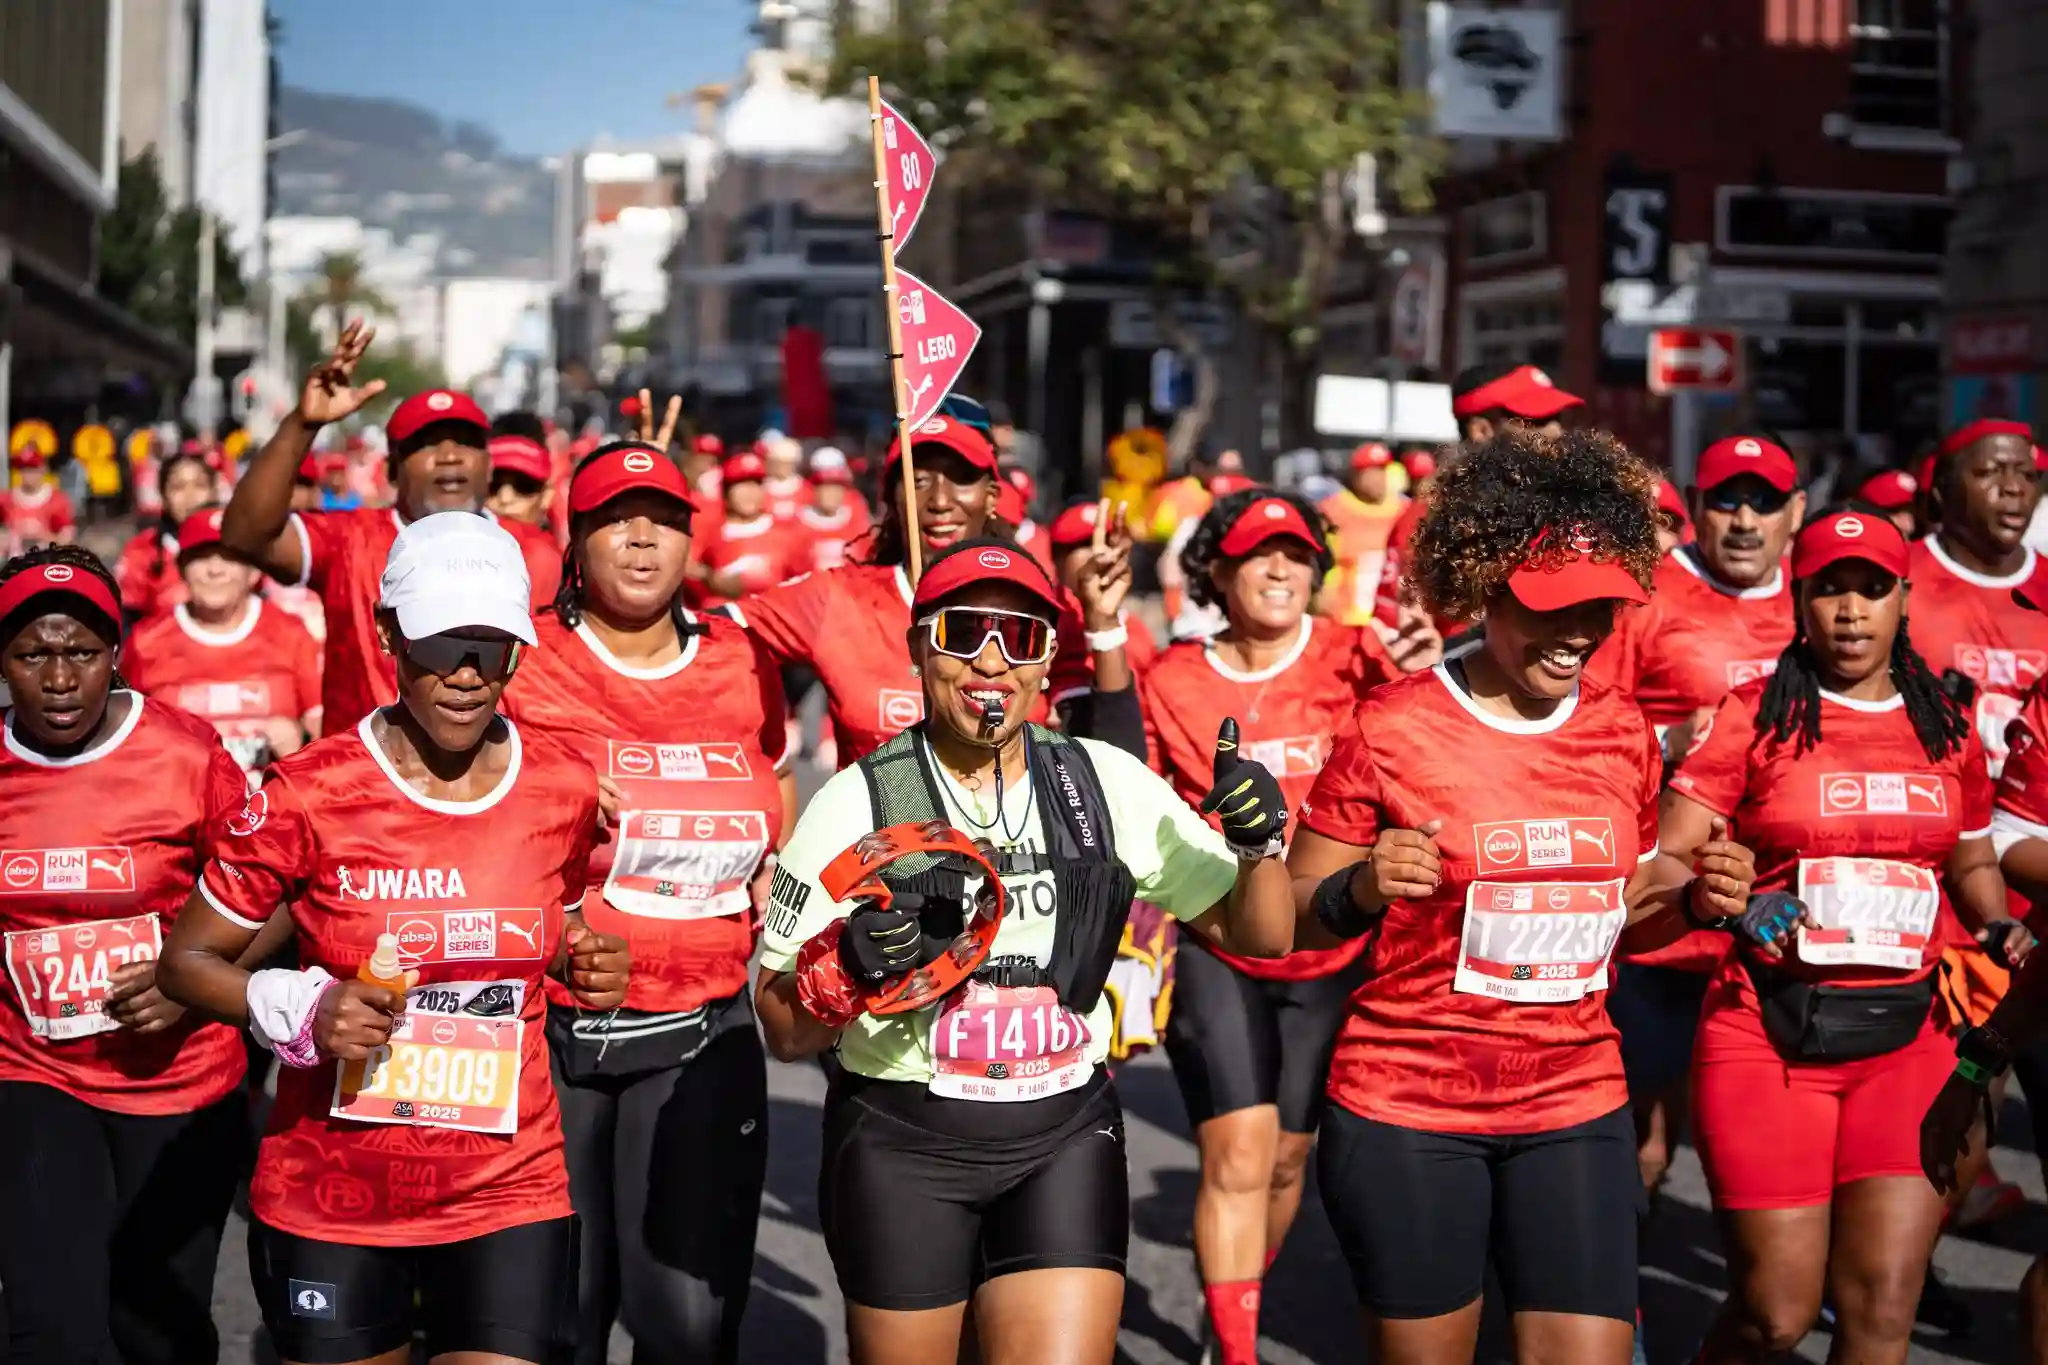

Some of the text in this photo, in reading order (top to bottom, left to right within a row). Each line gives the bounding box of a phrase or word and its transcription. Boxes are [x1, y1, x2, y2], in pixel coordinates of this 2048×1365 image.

[901, 151, 921, 191] 80
[917, 333, 956, 365] LEBO
[661, 749, 698, 761] RUN
[1075, 811, 1096, 847] Rock
[1528, 825, 1567, 841] RUN
[48, 854, 84, 869] RUN
[1531, 848, 1566, 859] SERIES
[359, 867, 467, 900] JWARA
[771, 862, 812, 916] UMA
[448, 915, 493, 933] RUN
[401, 930, 433, 943] absa
[1505, 914, 1620, 962] 22236
[448, 940, 489, 952] SERIES
[1513, 964, 1578, 979] ASA 2025
[62, 1003, 76, 1011] ASA
[416, 987, 512, 1014] 2025 ASA
[949, 1010, 971, 1059] F
[395, 1046, 499, 1105] 3909
[988, 1057, 1050, 1077] ASA 2025
[961, 1080, 1049, 1097] BAG TAG F 14167
[395, 1102, 461, 1120] ASA 2025
